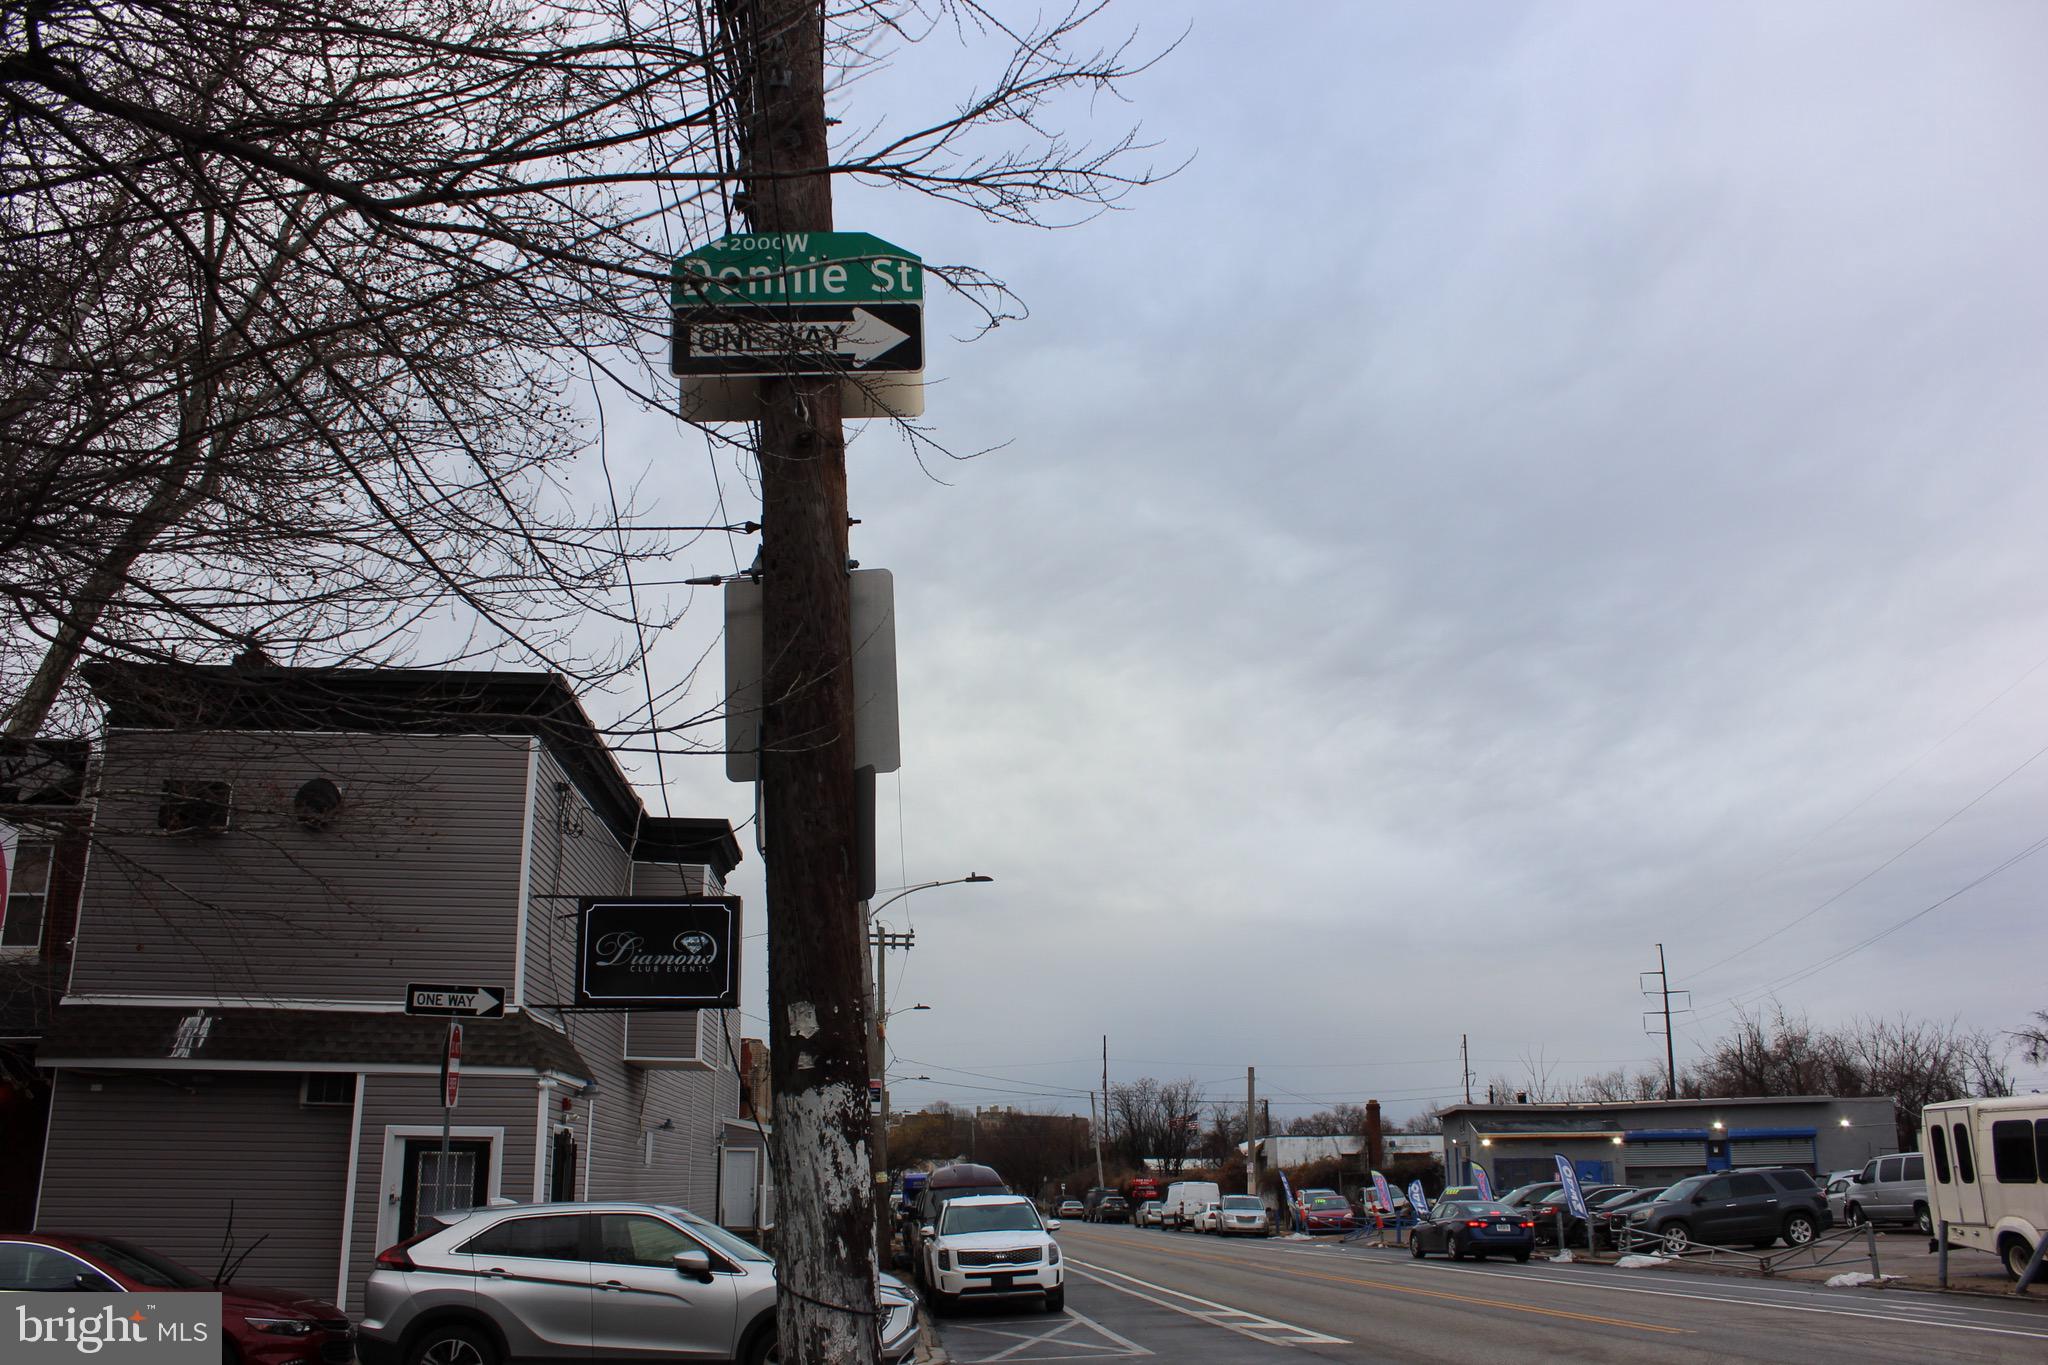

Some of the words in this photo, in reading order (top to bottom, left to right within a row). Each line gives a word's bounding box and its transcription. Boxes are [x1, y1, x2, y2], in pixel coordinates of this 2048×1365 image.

[871, 257, 914, 294] St
[596, 930, 718, 966] Diamond
[630, 965, 658, 973] CLUB
[417, 993, 443, 1006] ONE
[448, 994, 475, 1007] WAY
